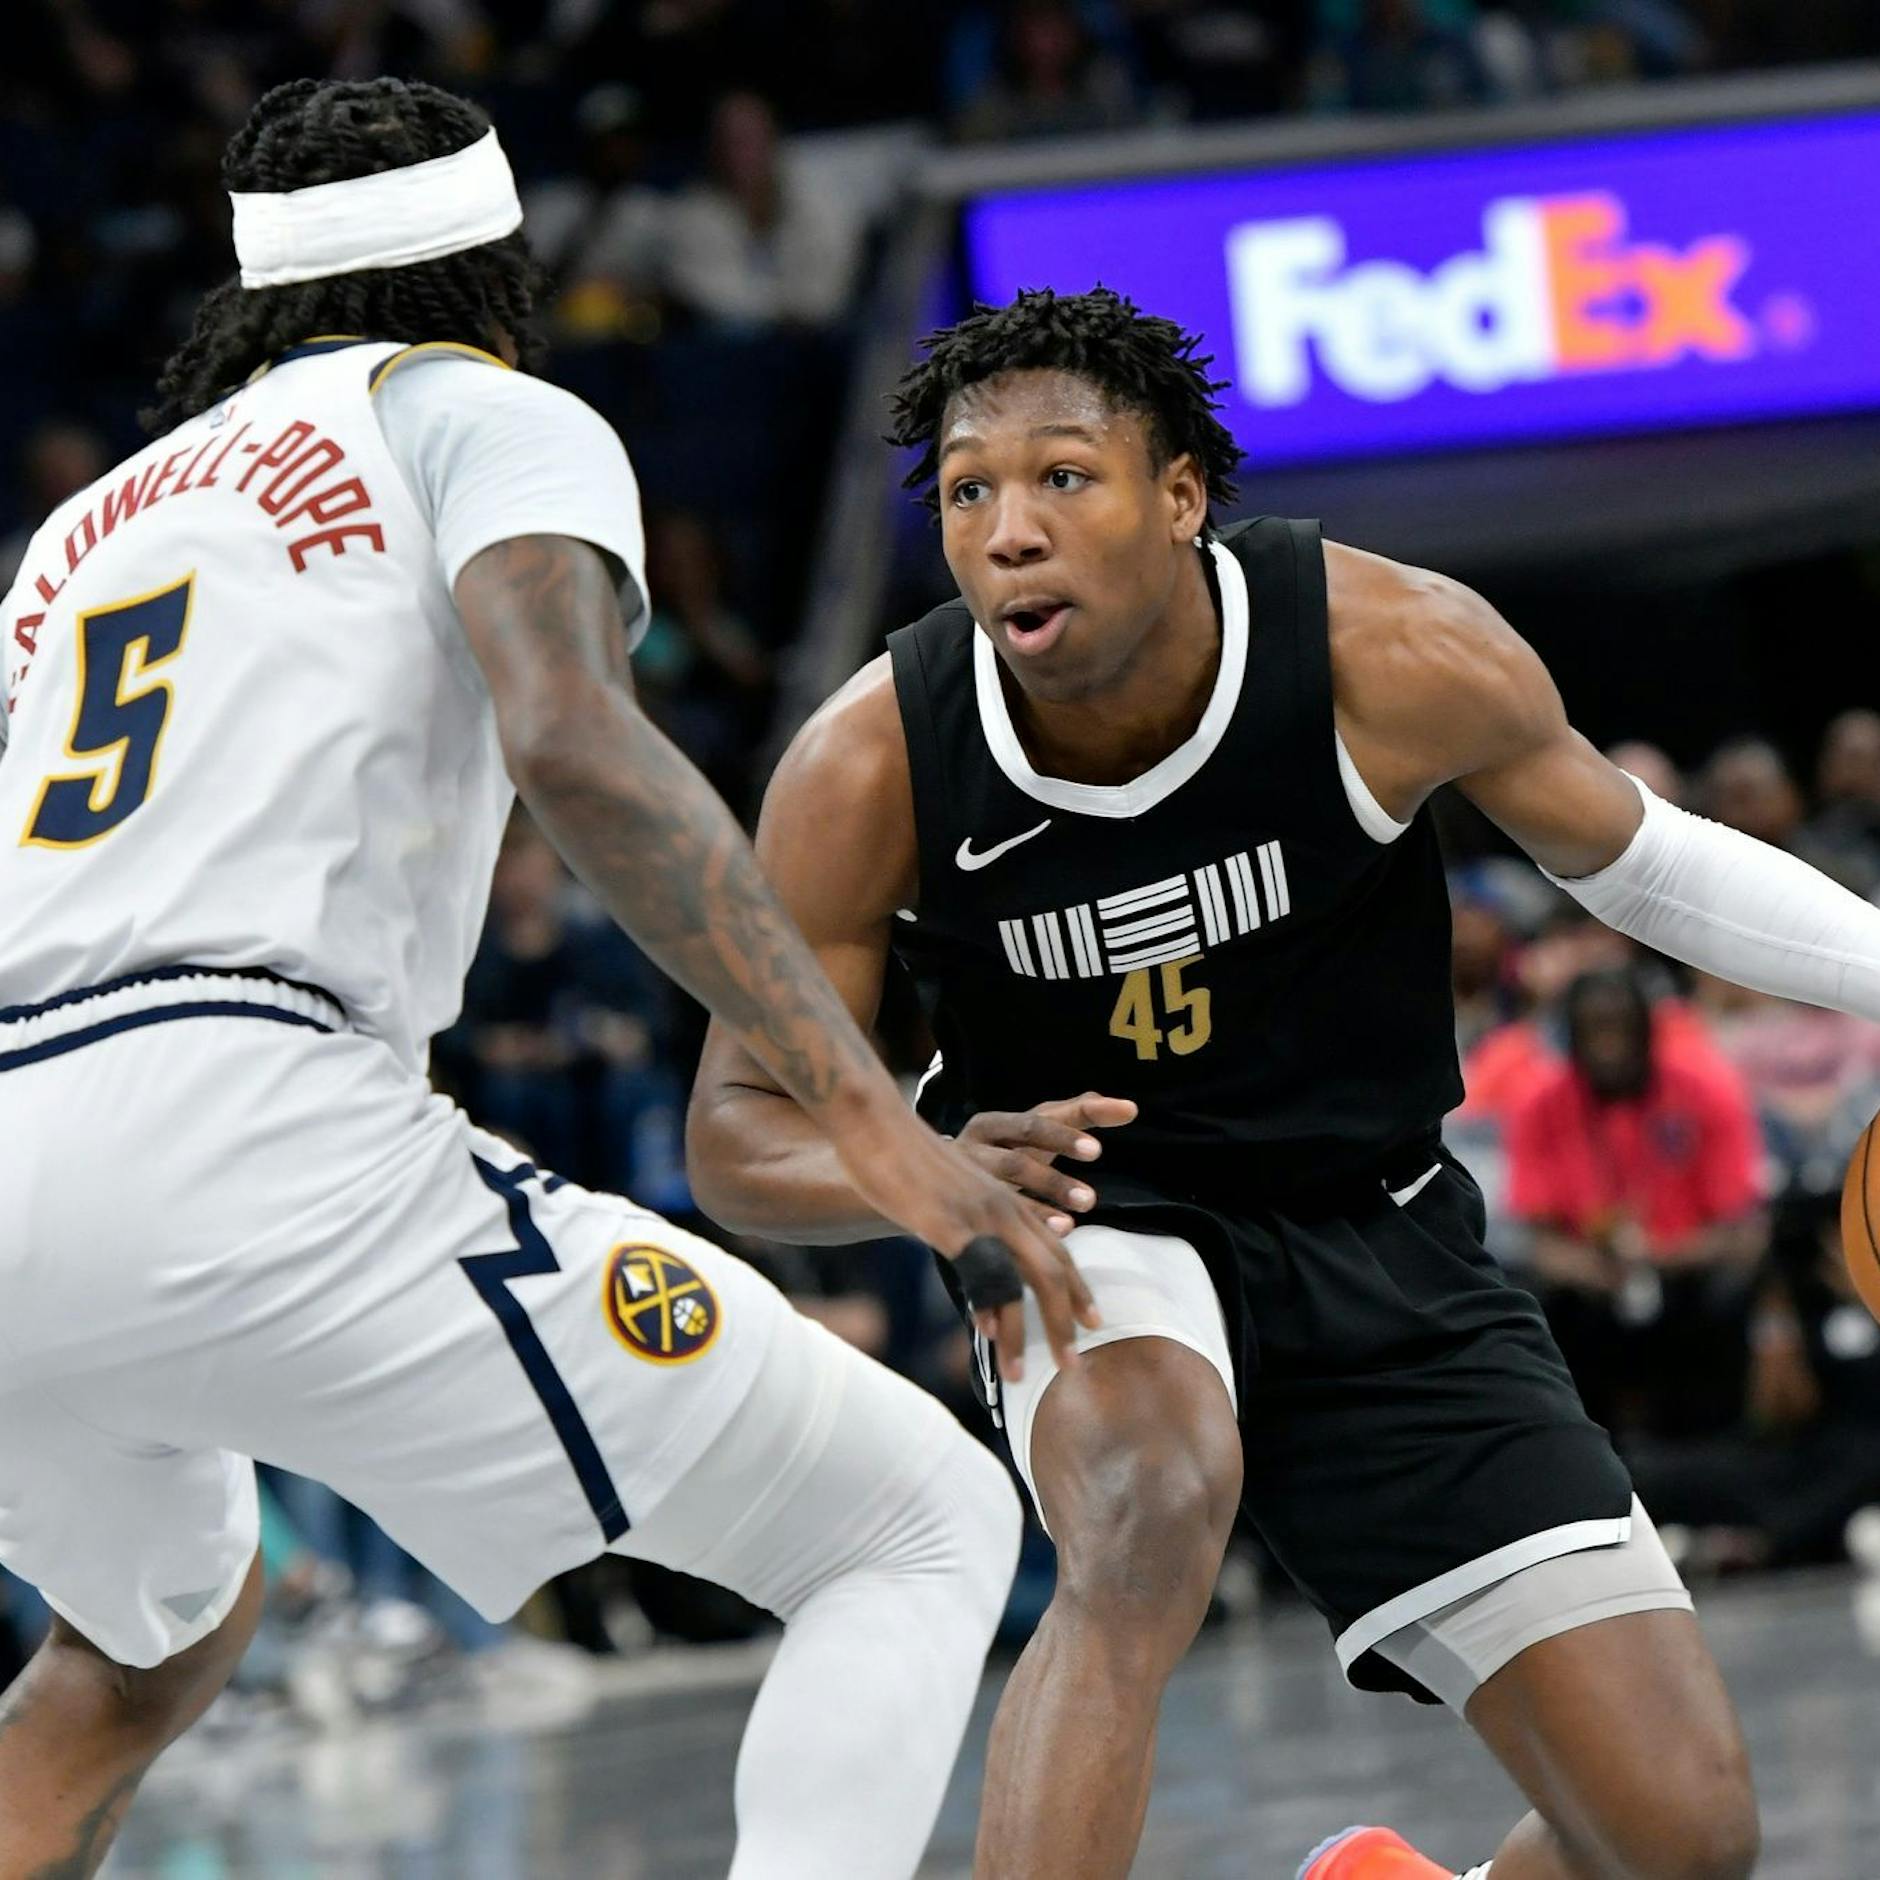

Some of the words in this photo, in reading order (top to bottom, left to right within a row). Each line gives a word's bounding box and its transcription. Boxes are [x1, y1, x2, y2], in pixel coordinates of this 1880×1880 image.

[1226, 192, 1753, 406] FedEx
[18, 568, 196, 848] 5
[1109, 953, 1212, 1061] 45
